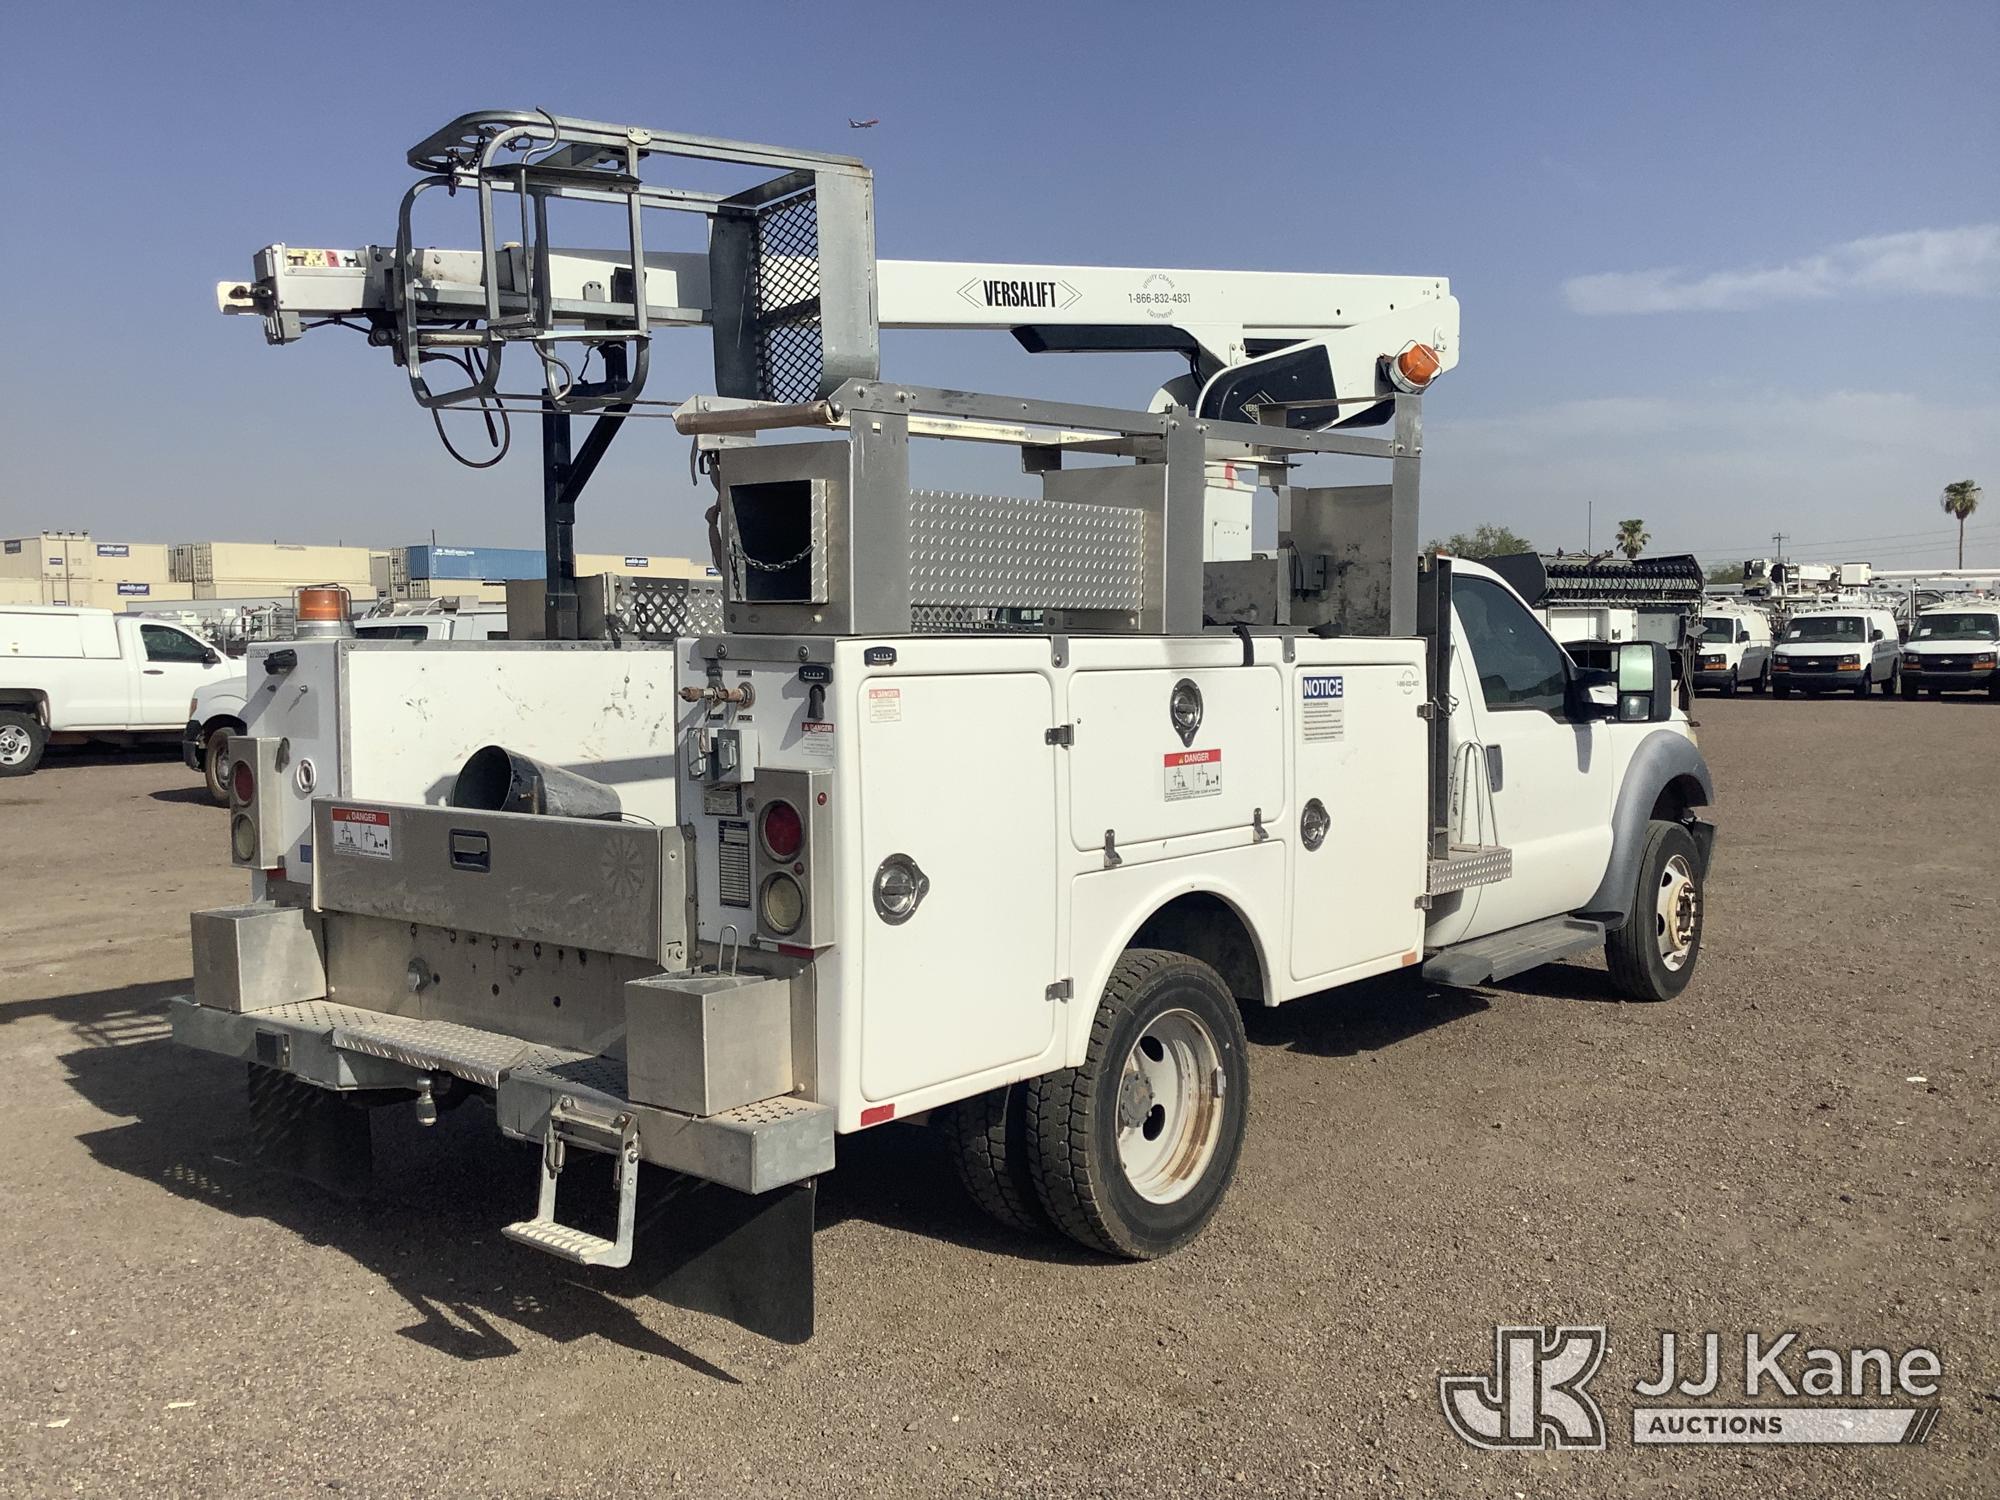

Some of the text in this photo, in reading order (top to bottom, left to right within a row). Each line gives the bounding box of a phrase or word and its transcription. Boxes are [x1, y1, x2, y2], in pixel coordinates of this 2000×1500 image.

[983, 279, 1056, 308] VERSALIFT
[1128, 293, 1191, 304] 1-866-832-4831
[1303, 679, 1343, 697] NOTICE
[1184, 752, 1210, 764] DANGER
[351, 811, 377, 822] DANGER
